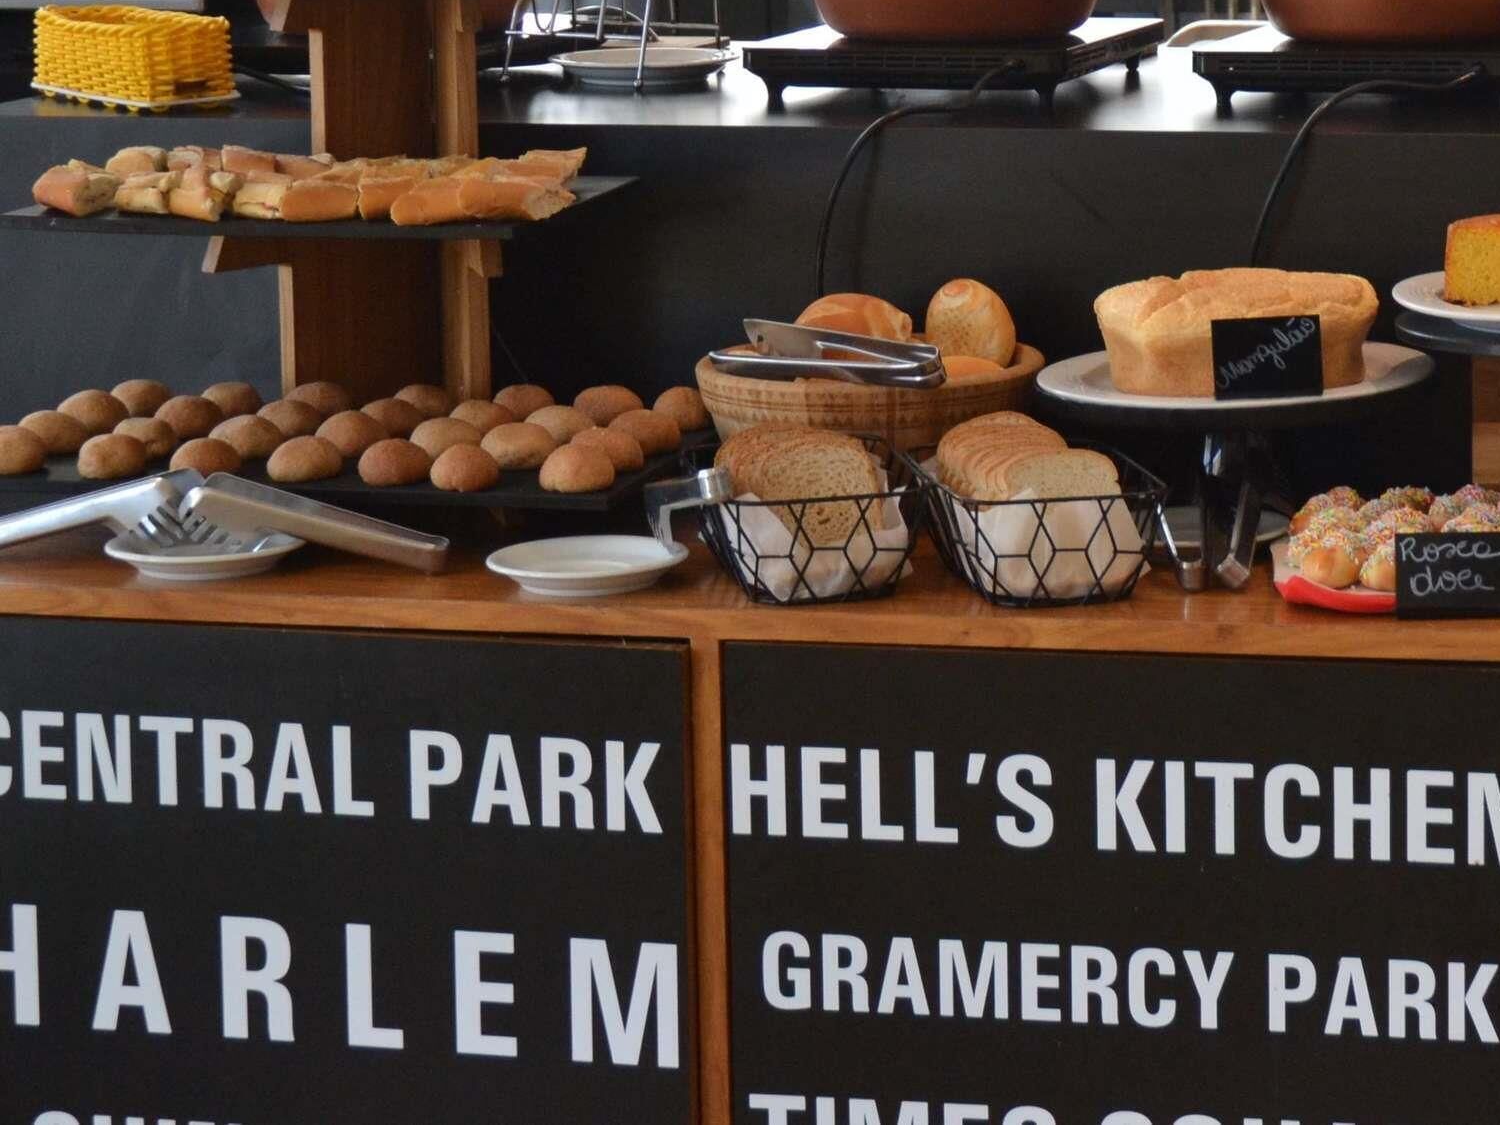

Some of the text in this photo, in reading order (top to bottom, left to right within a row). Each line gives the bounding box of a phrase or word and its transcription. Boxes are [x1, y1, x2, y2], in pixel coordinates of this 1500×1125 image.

[0, 709, 663, 834] ENTRAL PARK
[730, 743, 1055, 848] HELL'S
[761, 931, 1500, 1044] GRAMERCY PARK
